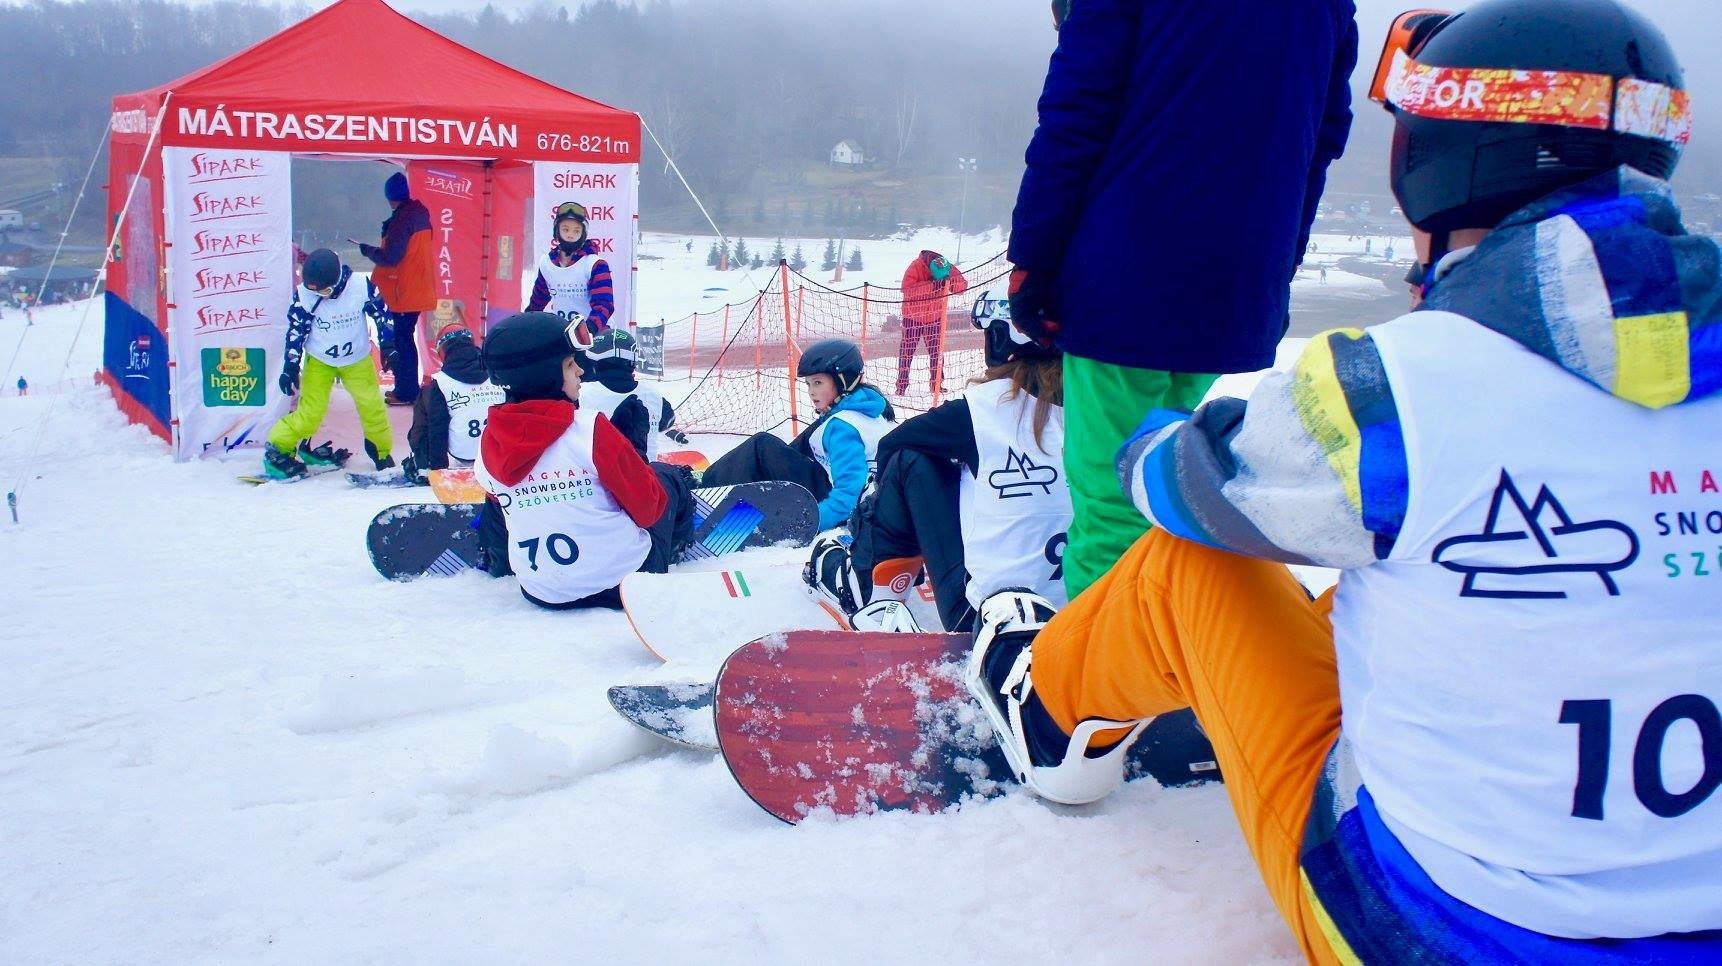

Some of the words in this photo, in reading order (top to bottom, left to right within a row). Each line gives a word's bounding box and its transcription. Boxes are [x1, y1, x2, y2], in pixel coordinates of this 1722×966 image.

[178, 103, 518, 148] MÁTRASZENTISTVÁN
[537, 133, 629, 153] 676-821m
[553, 169, 616, 188] SÍPARK
[325, 342, 353, 358] 42
[211, 373, 257, 391] happy
[220, 386, 249, 404] day
[468, 419, 488, 438] 8
[514, 478, 592, 497] SNOWBOARD
[517, 488, 594, 508] SZÖVETSÉG
[518, 533, 580, 572] 70
